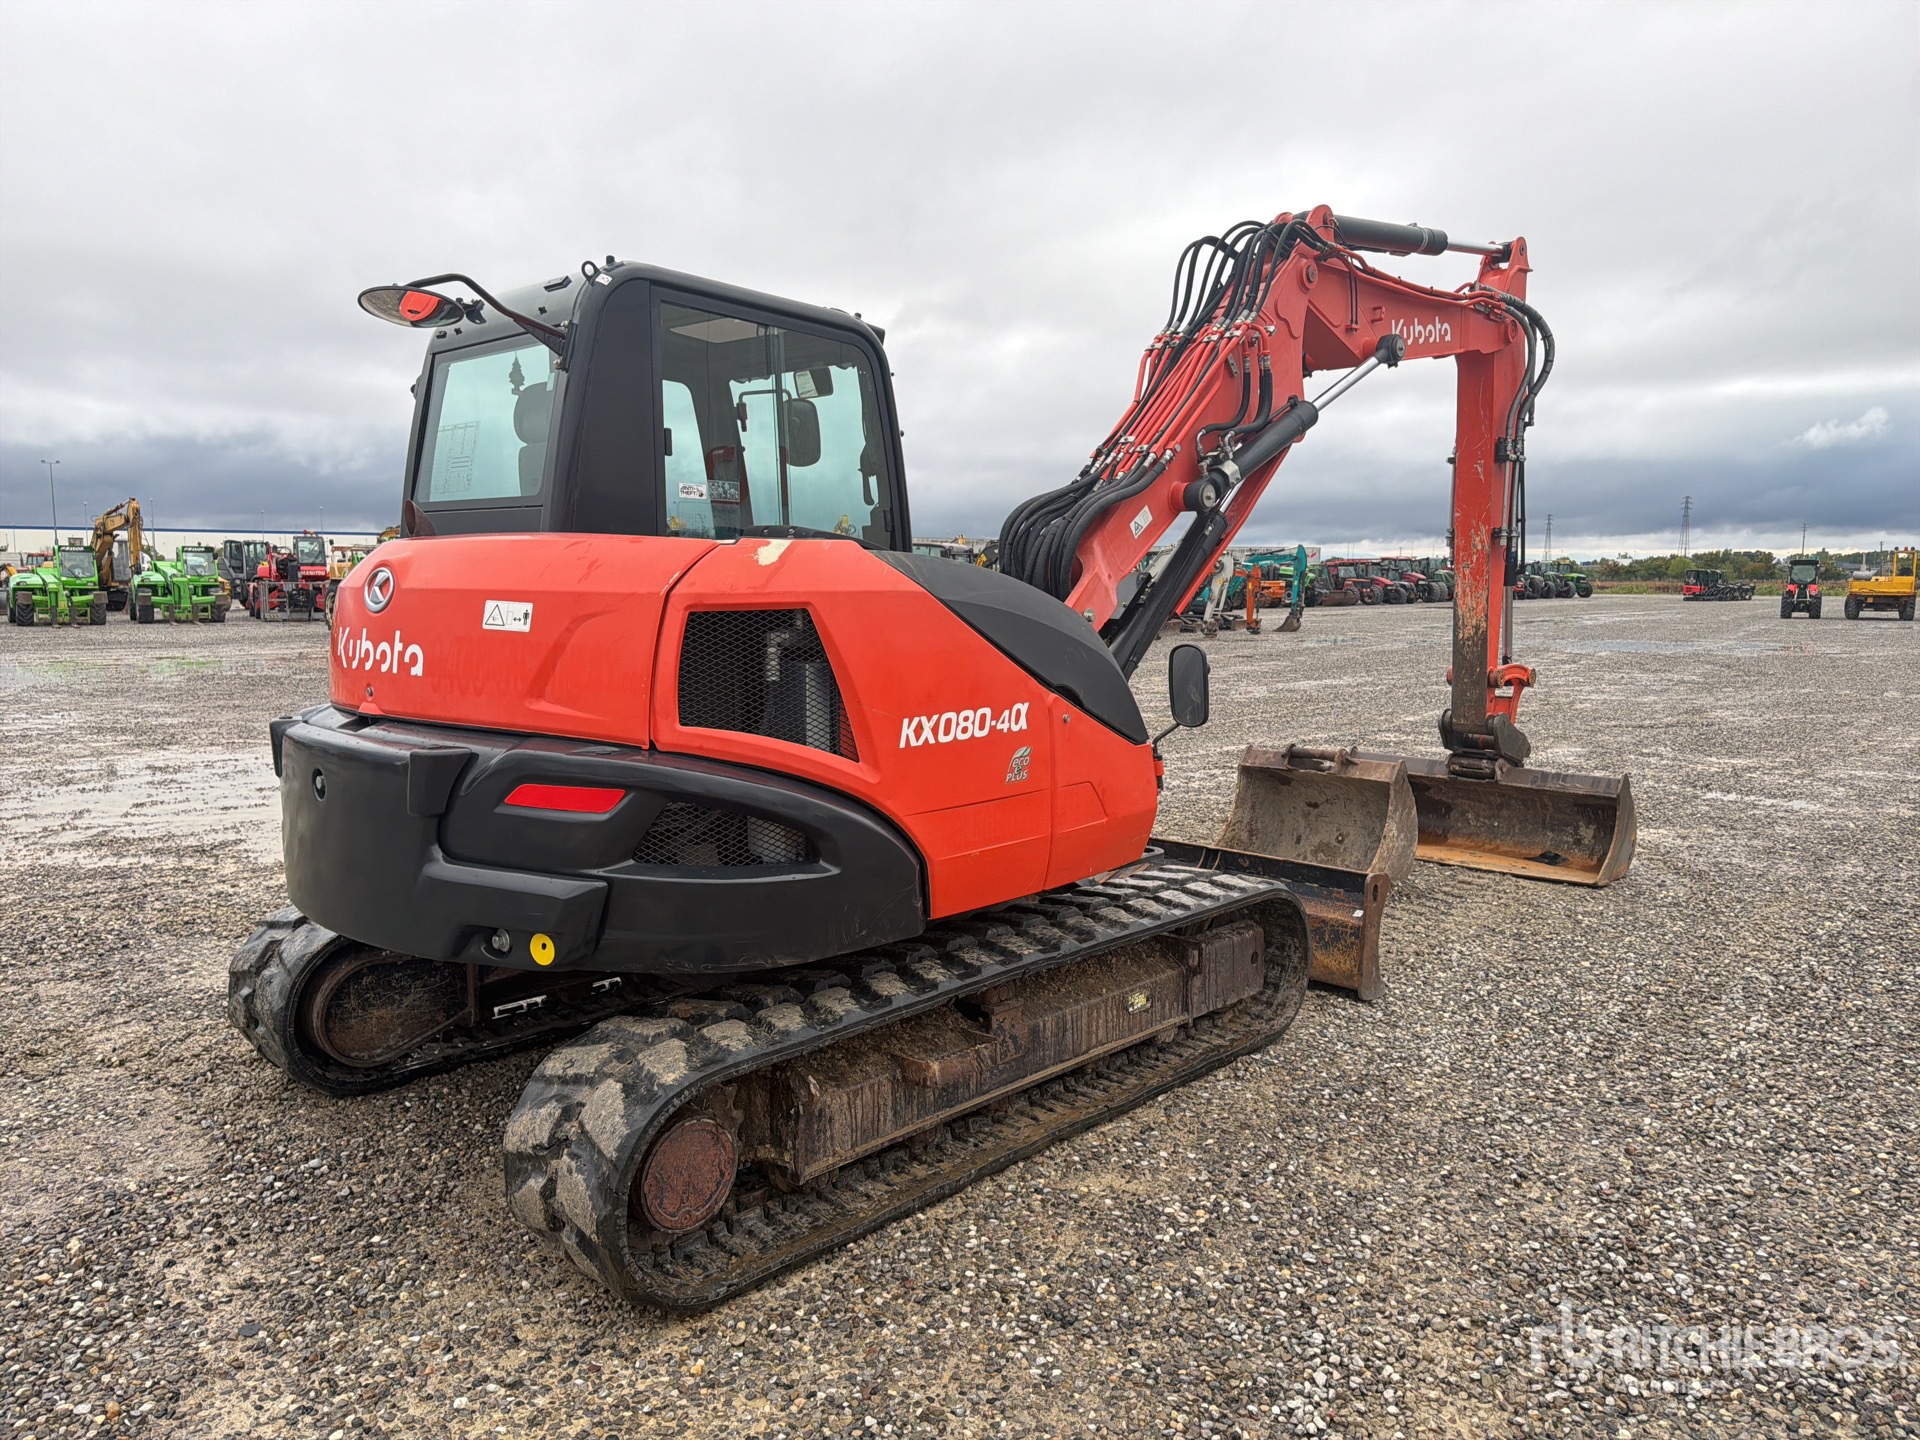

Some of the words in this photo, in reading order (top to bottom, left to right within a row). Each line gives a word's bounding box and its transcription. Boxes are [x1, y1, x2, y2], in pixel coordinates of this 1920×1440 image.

[338, 626, 424, 677] Kubota
[1012, 757, 1031, 767] eco
[1005, 770, 1029, 784] PLUS
